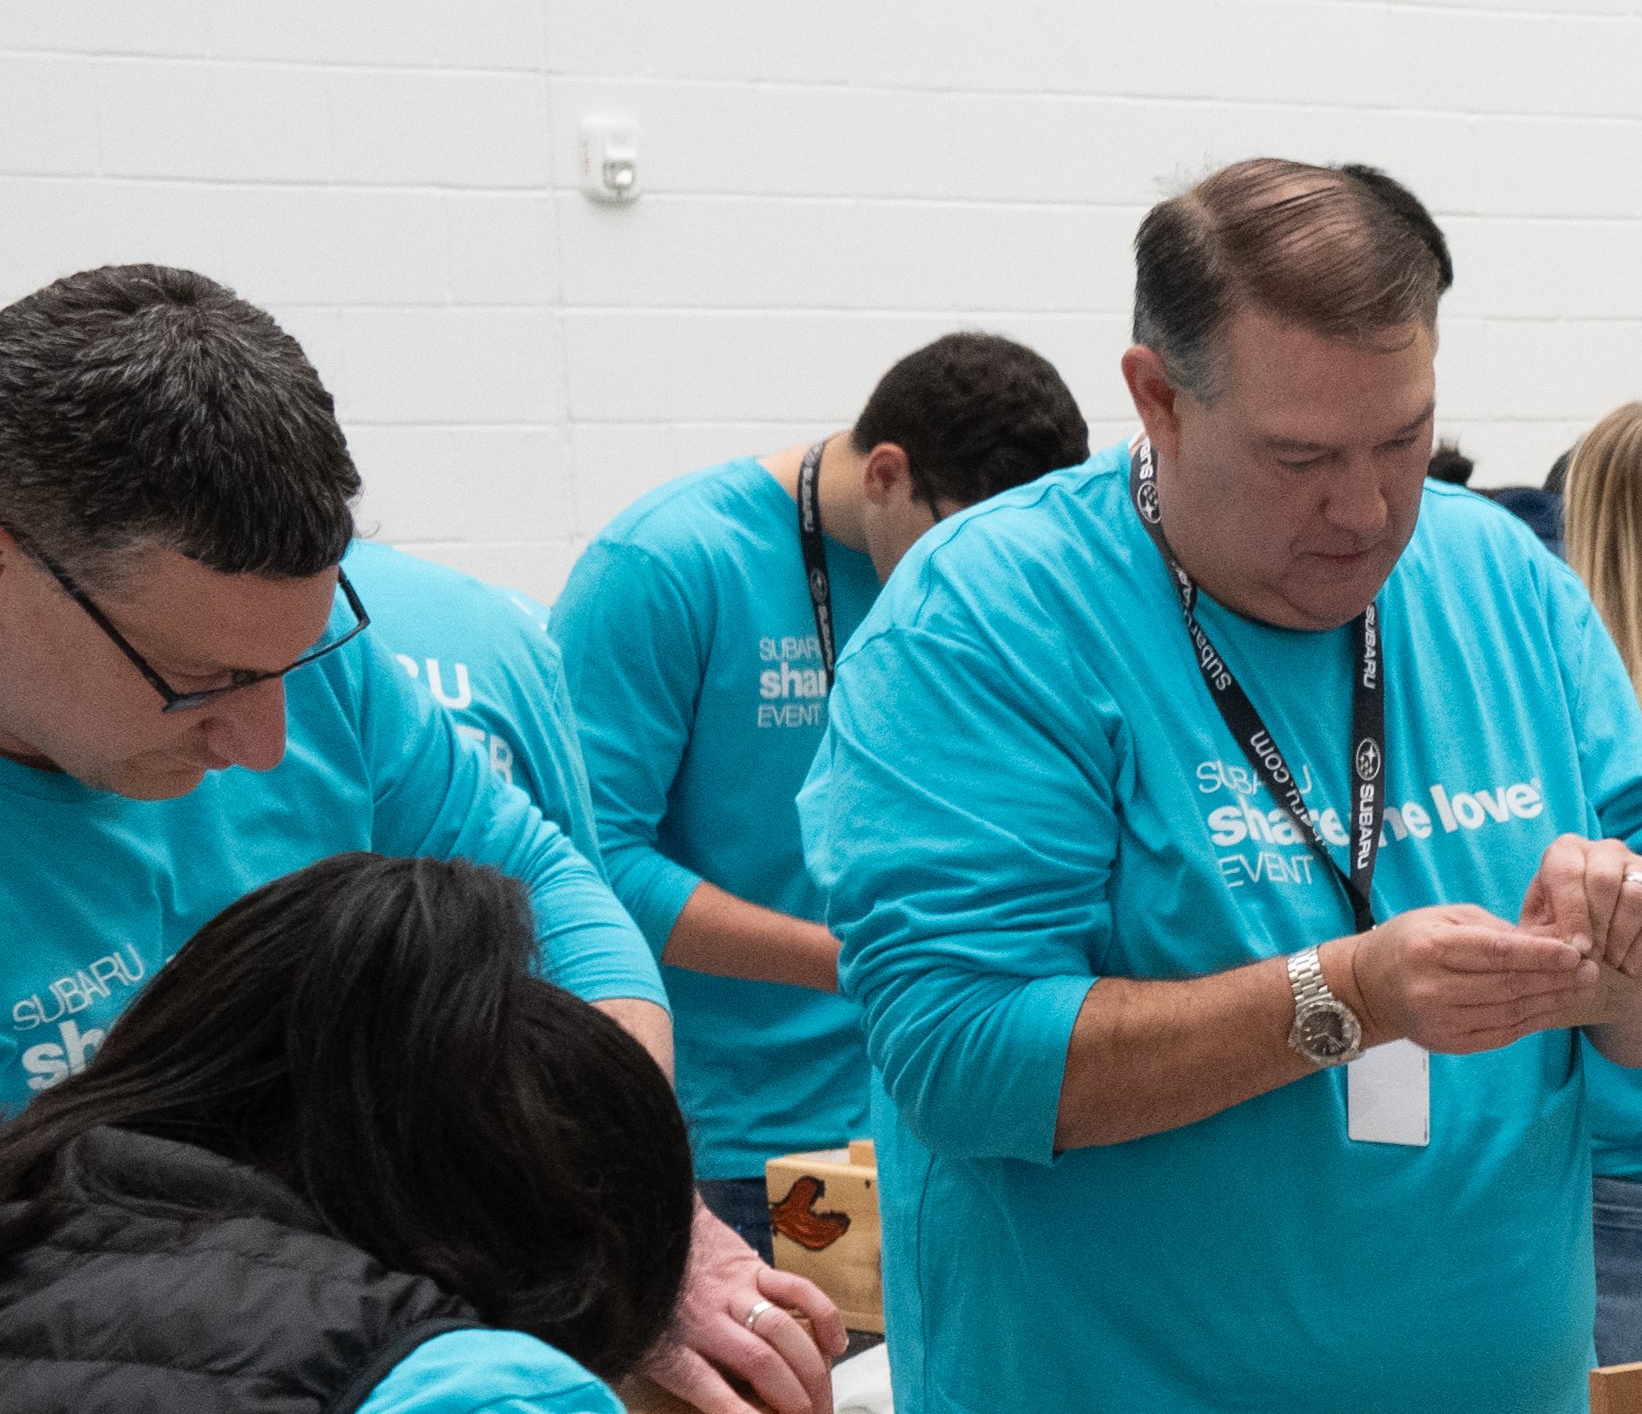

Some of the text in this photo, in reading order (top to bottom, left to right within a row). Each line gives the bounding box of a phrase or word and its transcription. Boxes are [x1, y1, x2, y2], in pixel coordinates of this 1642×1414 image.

[1219, 851, 1314, 888] EVENT
[1356, 783, 1375, 870] SUBARU
[12, 942, 145, 1032] SUBARU
